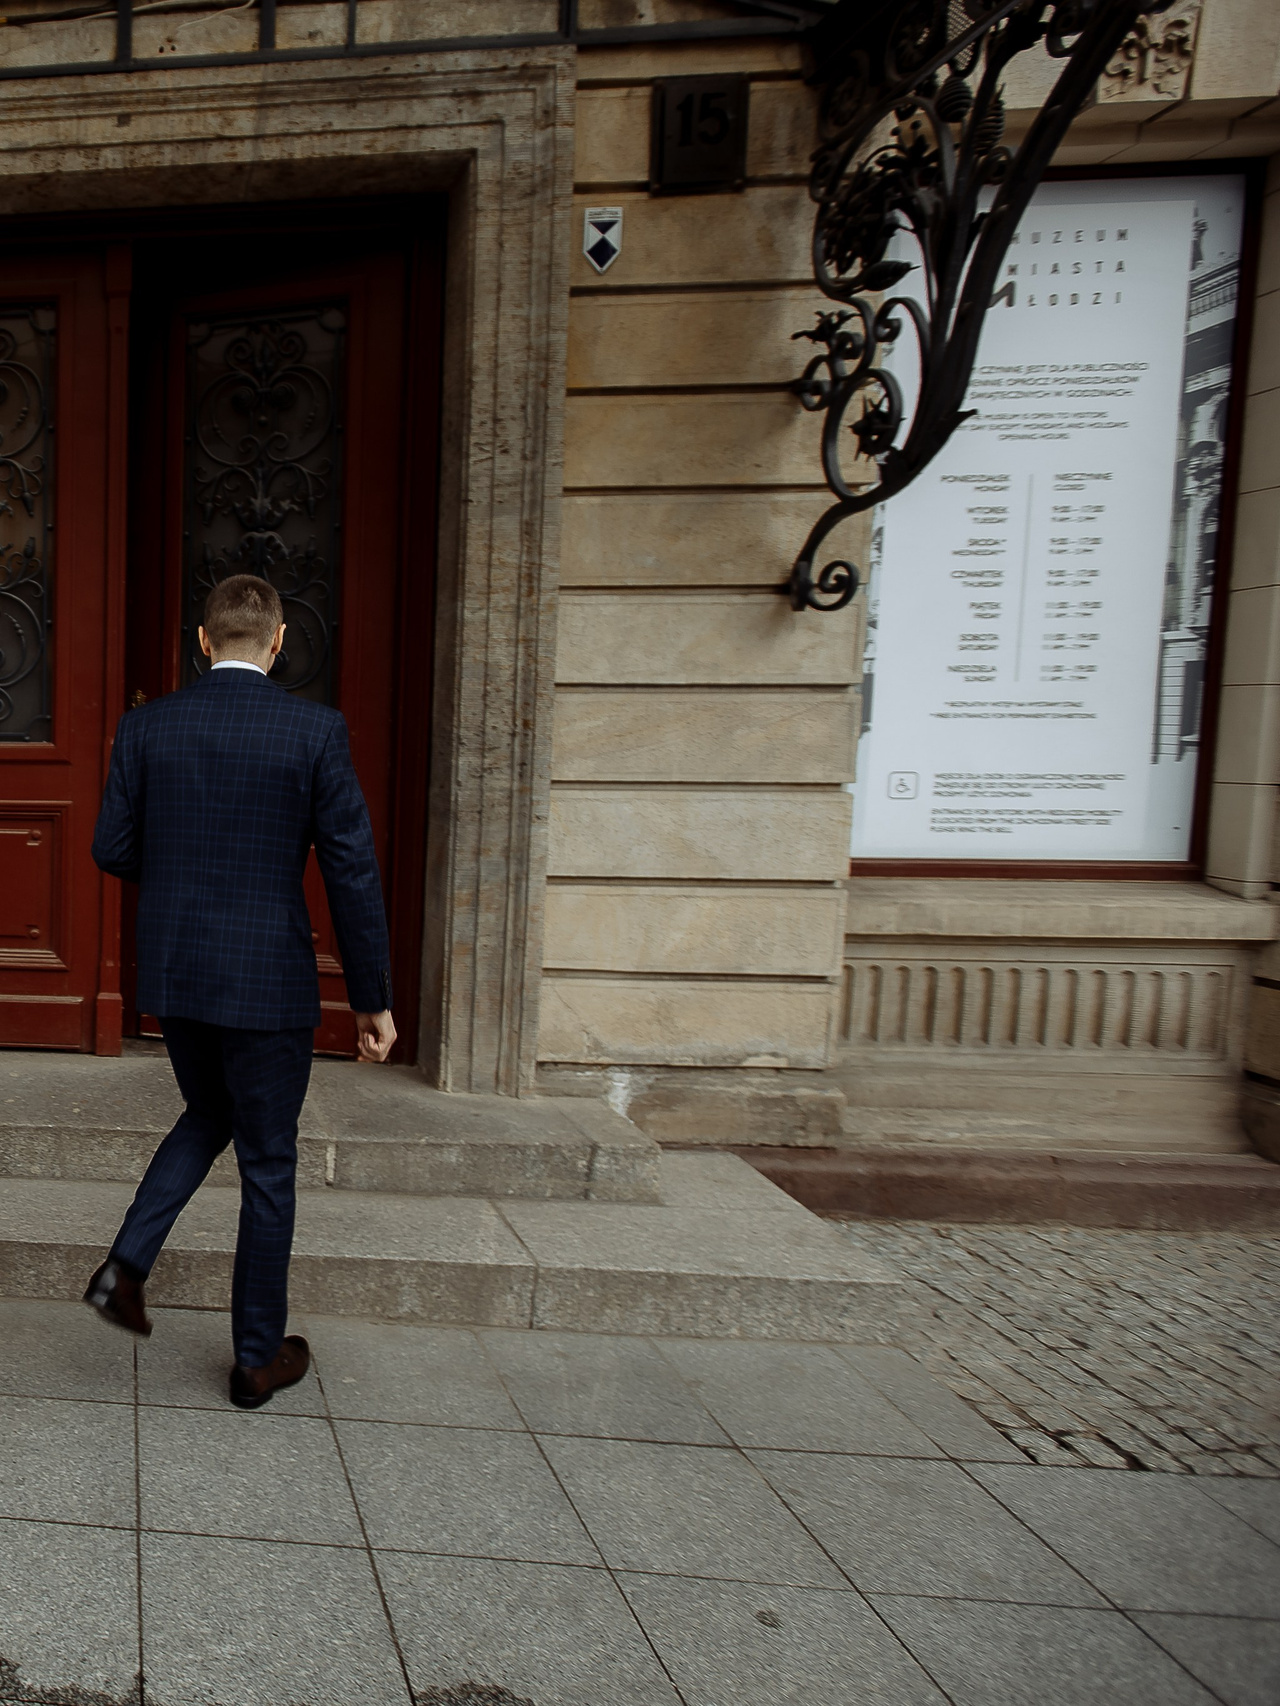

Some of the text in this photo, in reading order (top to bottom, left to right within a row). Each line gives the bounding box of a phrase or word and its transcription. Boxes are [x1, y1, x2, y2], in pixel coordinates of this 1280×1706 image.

[676, 92, 729, 147] 15
[1006, 260, 1126, 276] MIASTA
[1027, 291, 1122, 307] ŁODZI
